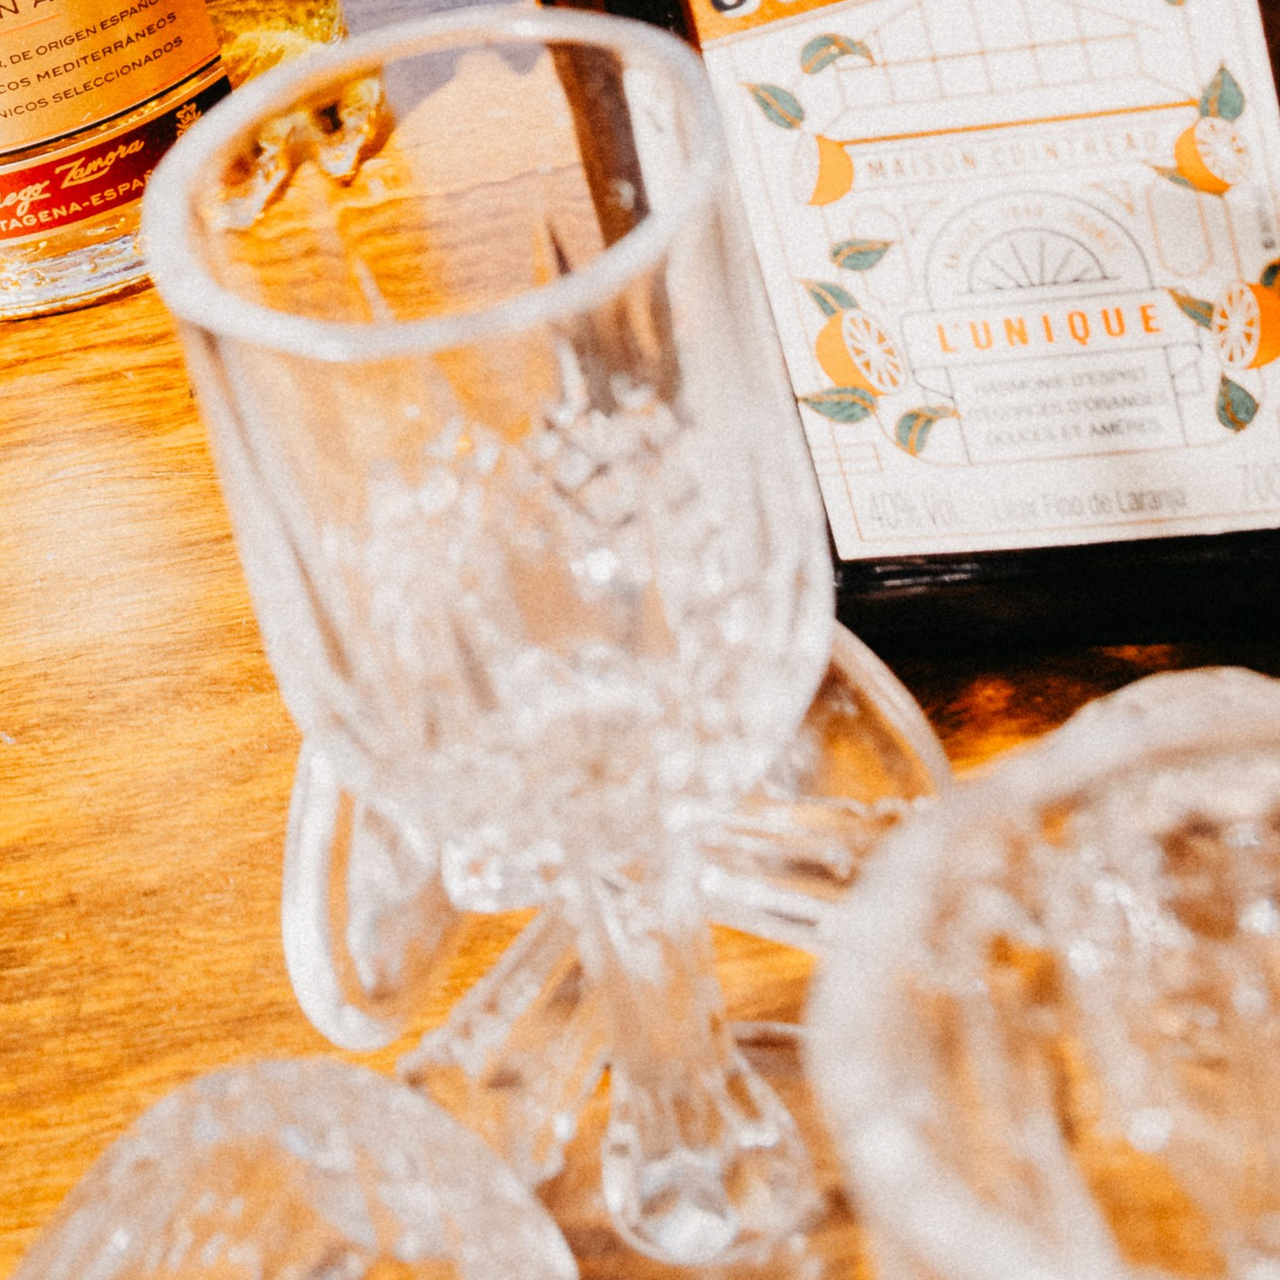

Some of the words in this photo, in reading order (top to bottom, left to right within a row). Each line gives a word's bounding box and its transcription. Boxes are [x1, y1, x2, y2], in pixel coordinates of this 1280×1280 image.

[9, 49, 34, 66] DE
[35, 24, 98, 57] ORIGEN
[36, 11, 178, 83] MEDITERRÁNEOS
[51, 35, 185, 104] SELECCIONADOS
[54, 139, 145, 190] Zamora
[935, 302, 1163, 354] L'UNIQUE
